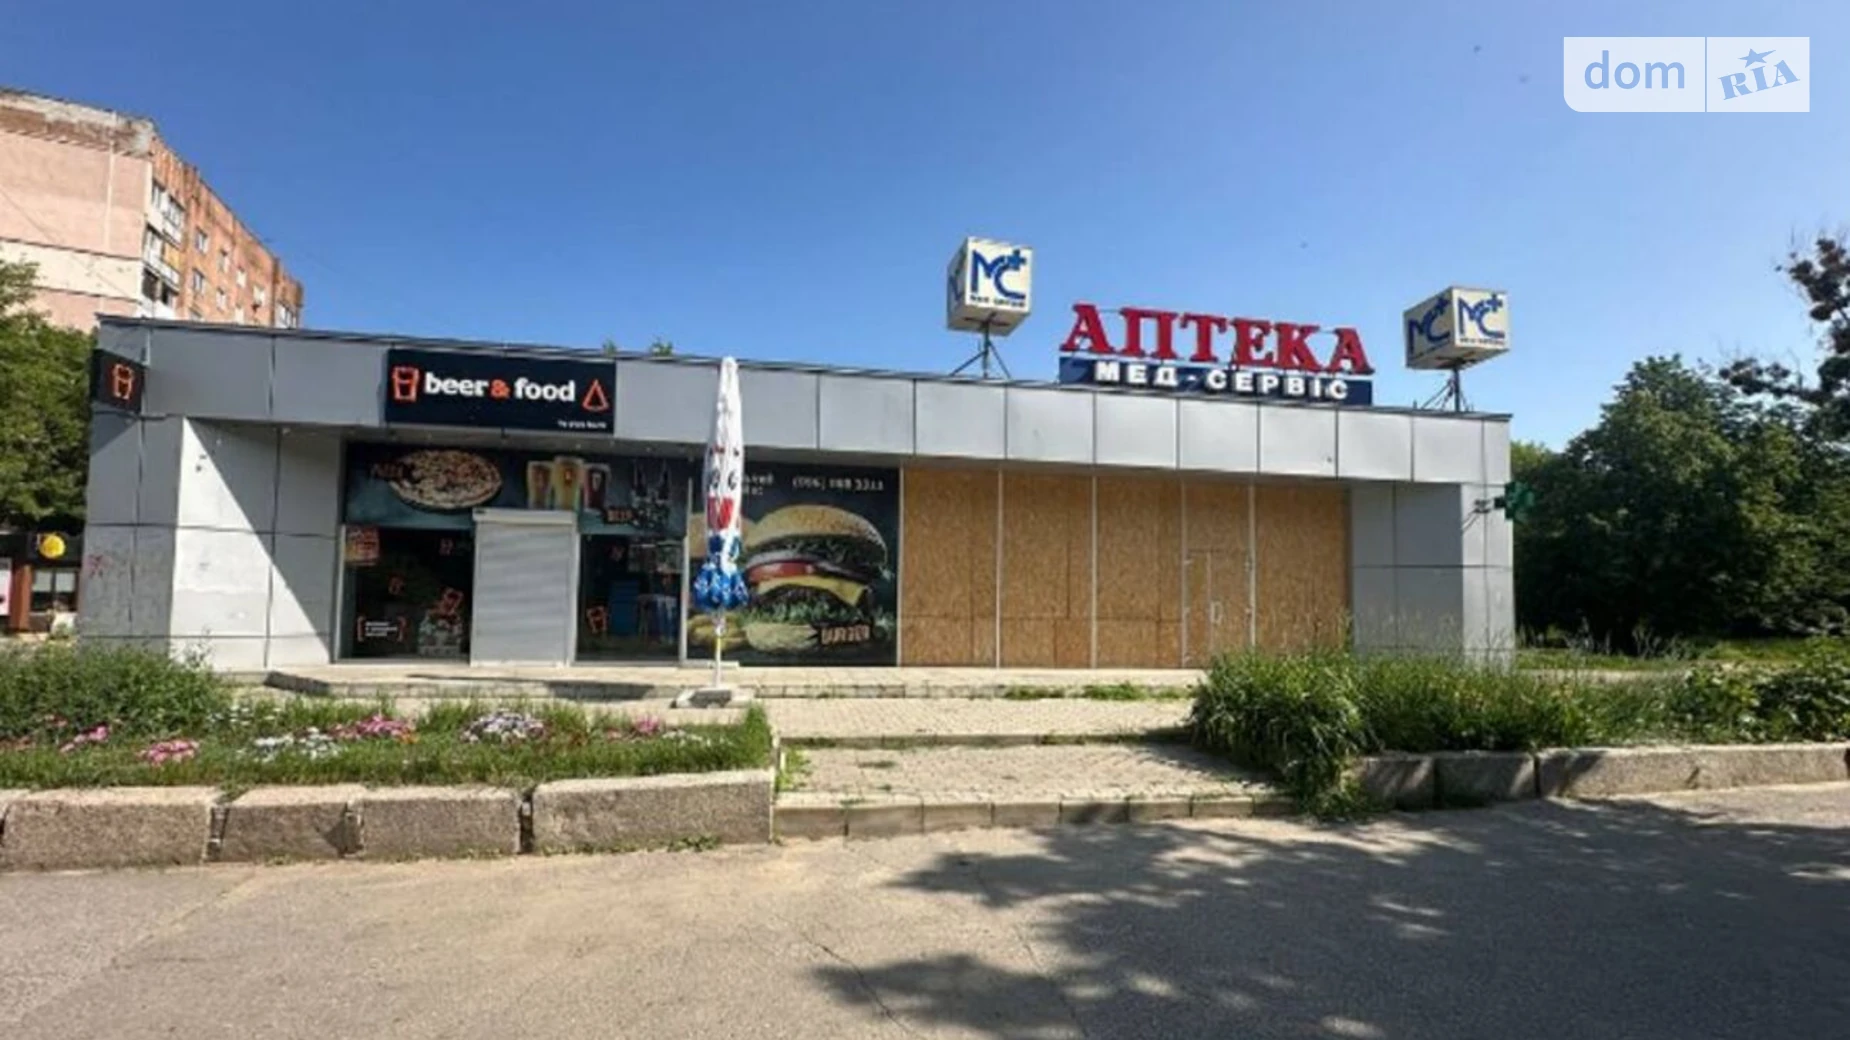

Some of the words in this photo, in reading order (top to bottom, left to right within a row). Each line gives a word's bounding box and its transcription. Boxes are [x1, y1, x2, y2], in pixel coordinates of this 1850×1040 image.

[1059, 303, 1375, 374] АПТЕКА
[424, 371, 489, 397] beer
[513, 377, 576, 401] food
